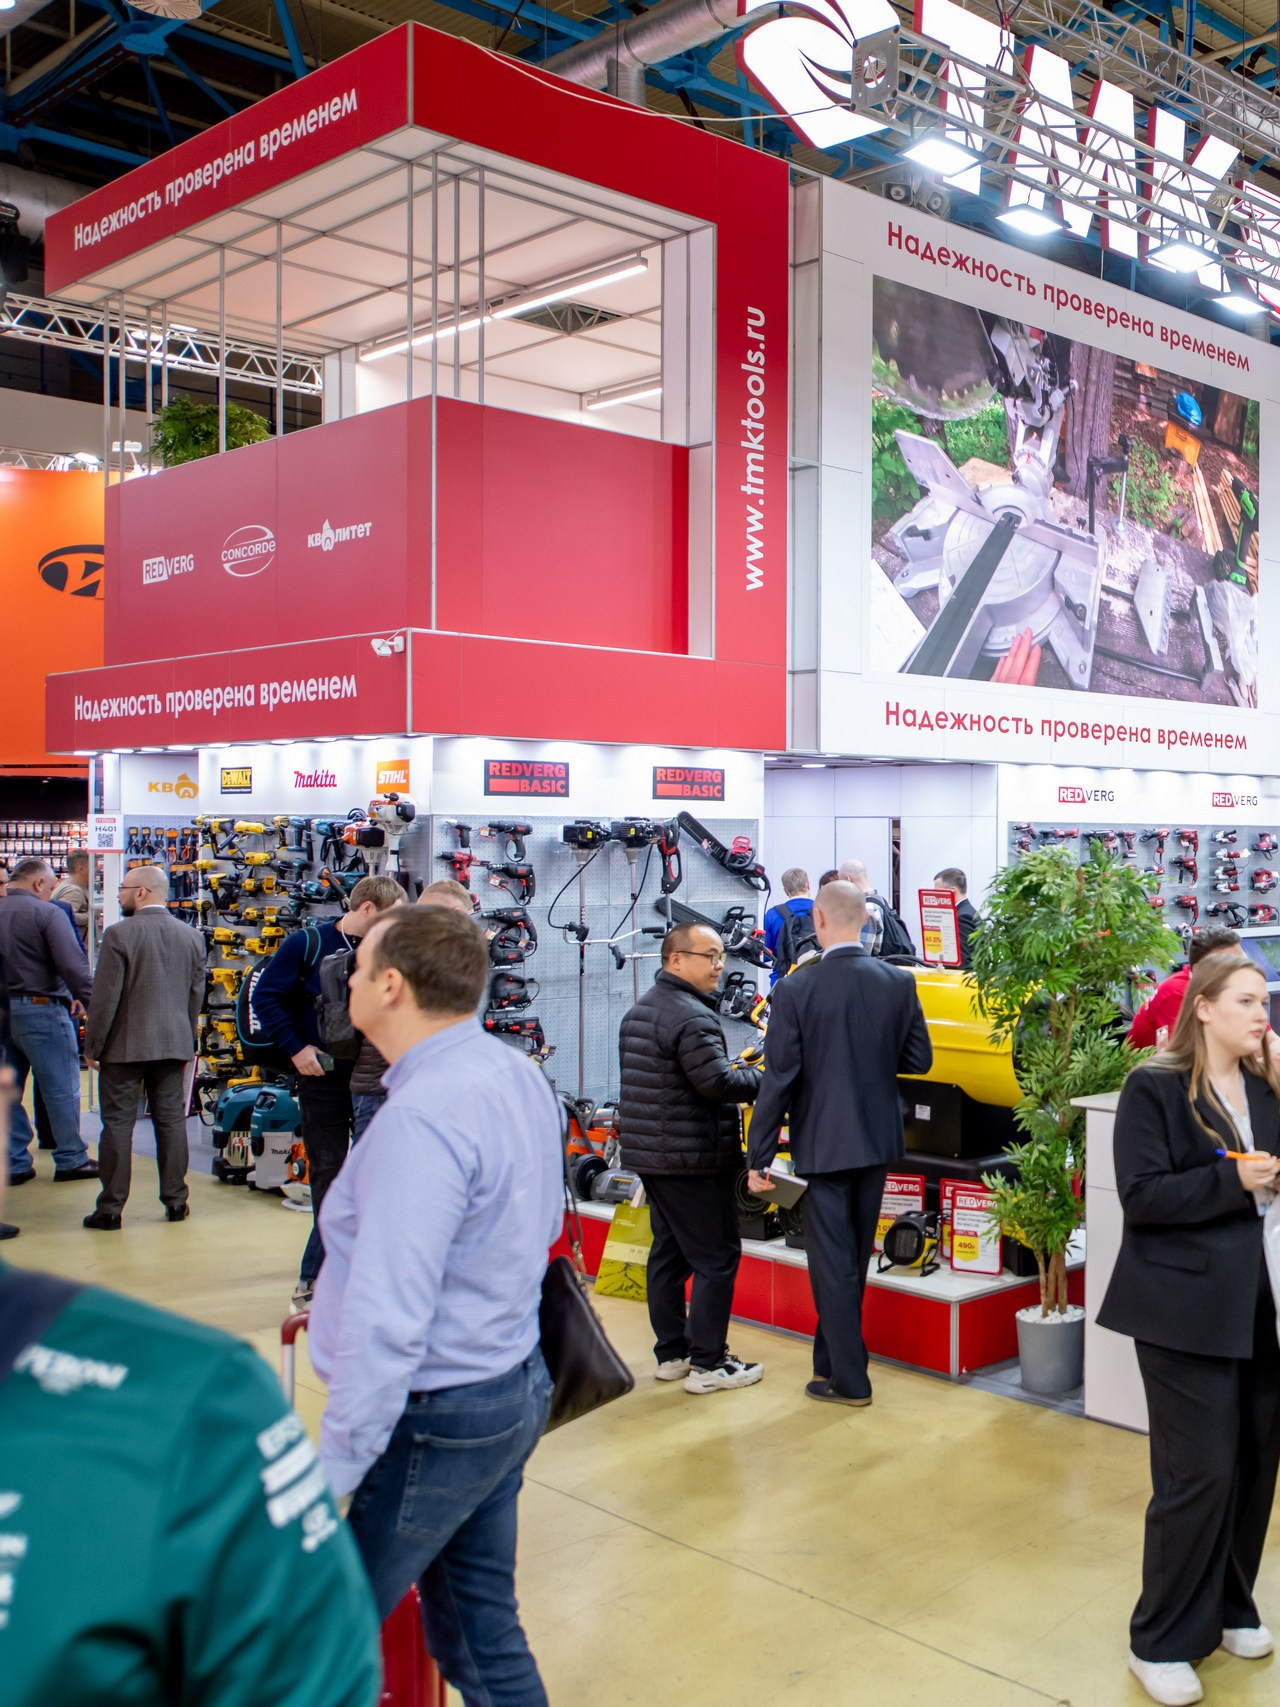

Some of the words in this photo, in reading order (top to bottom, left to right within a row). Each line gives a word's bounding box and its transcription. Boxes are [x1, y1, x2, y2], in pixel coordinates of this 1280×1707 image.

[74, 191, 161, 251] Надежность
[165, 142, 255, 206] проверена
[260, 88, 358, 160] временем
[887, 221, 1036, 295] Надежность
[1043, 277, 1154, 338] проверена
[1160, 323, 1250, 372] временем
[740, 306, 766, 591] www.tmktools.ru
[74, 693, 162, 723] Надежность
[165, 684, 255, 718] проверена
[260, 674, 358, 711] временем
[885, 701, 1034, 736] Надежность
[1041, 720, 1152, 747] проверена
[1157, 729, 1248, 750] временем
[377, 770, 407, 785] STIHL
[488, 761, 566, 778] REDVERG
[655, 768, 722, 783] REDVERG
[519, 778, 566, 793] BASIC
[682, 784, 722, 798] BASIC
[1058, 786, 1115, 803] REDVERG
[1212, 792, 1258, 808] REDVERG
